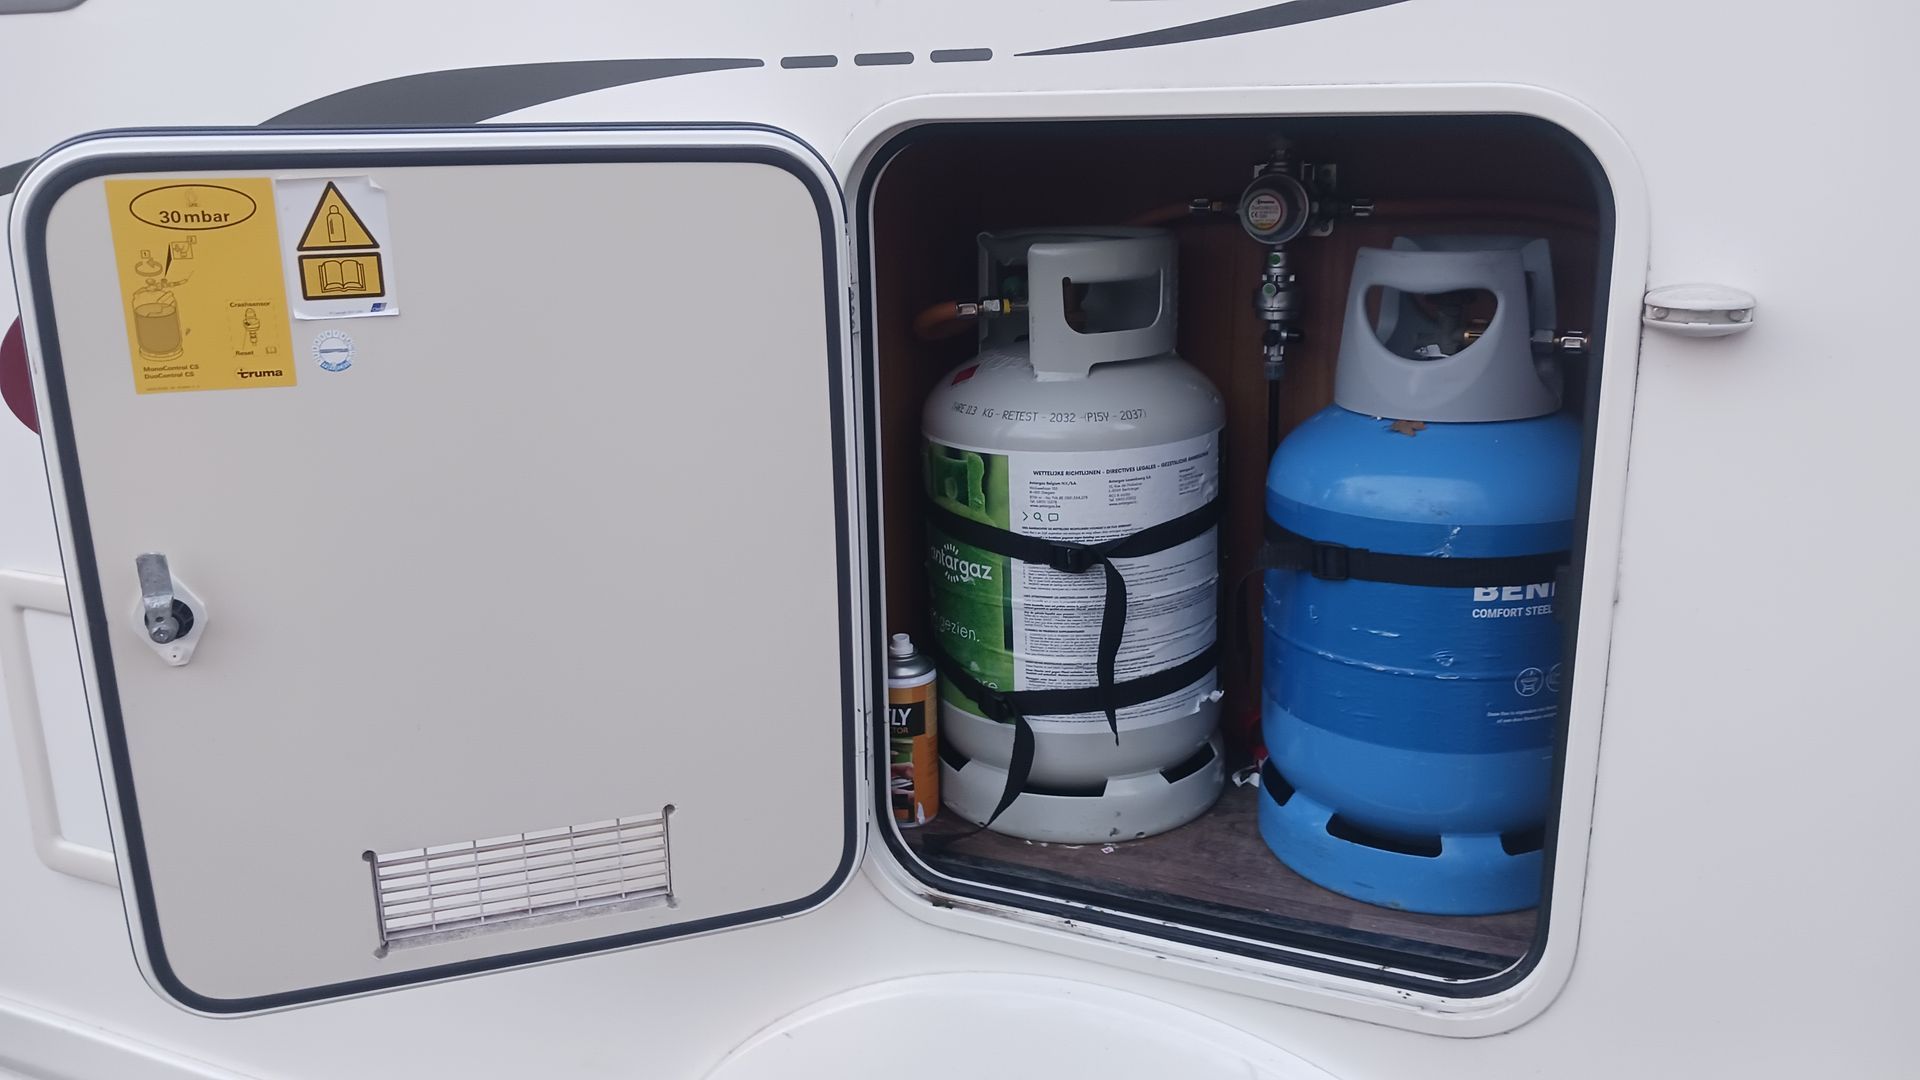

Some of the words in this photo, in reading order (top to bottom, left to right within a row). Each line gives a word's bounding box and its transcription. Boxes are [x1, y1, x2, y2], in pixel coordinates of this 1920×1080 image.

[159, 210, 181, 223] 30
[184, 210, 230, 223] mbar
[237, 368, 283, 379] truma
[982, 406, 994, 418] KG
[1002, 409, 1039, 422] RETEST
[1049, 412, 1077, 423] 2032
[1105, 466, 1136, 474] DIRECTIVES
[931, 546, 993, 583] antargaz
[1472, 581, 1556, 602] BEN
[1472, 607, 1524, 618] COMFORT
[1525, 604, 1552, 616] STEEL
[889, 707, 912, 726] LY
